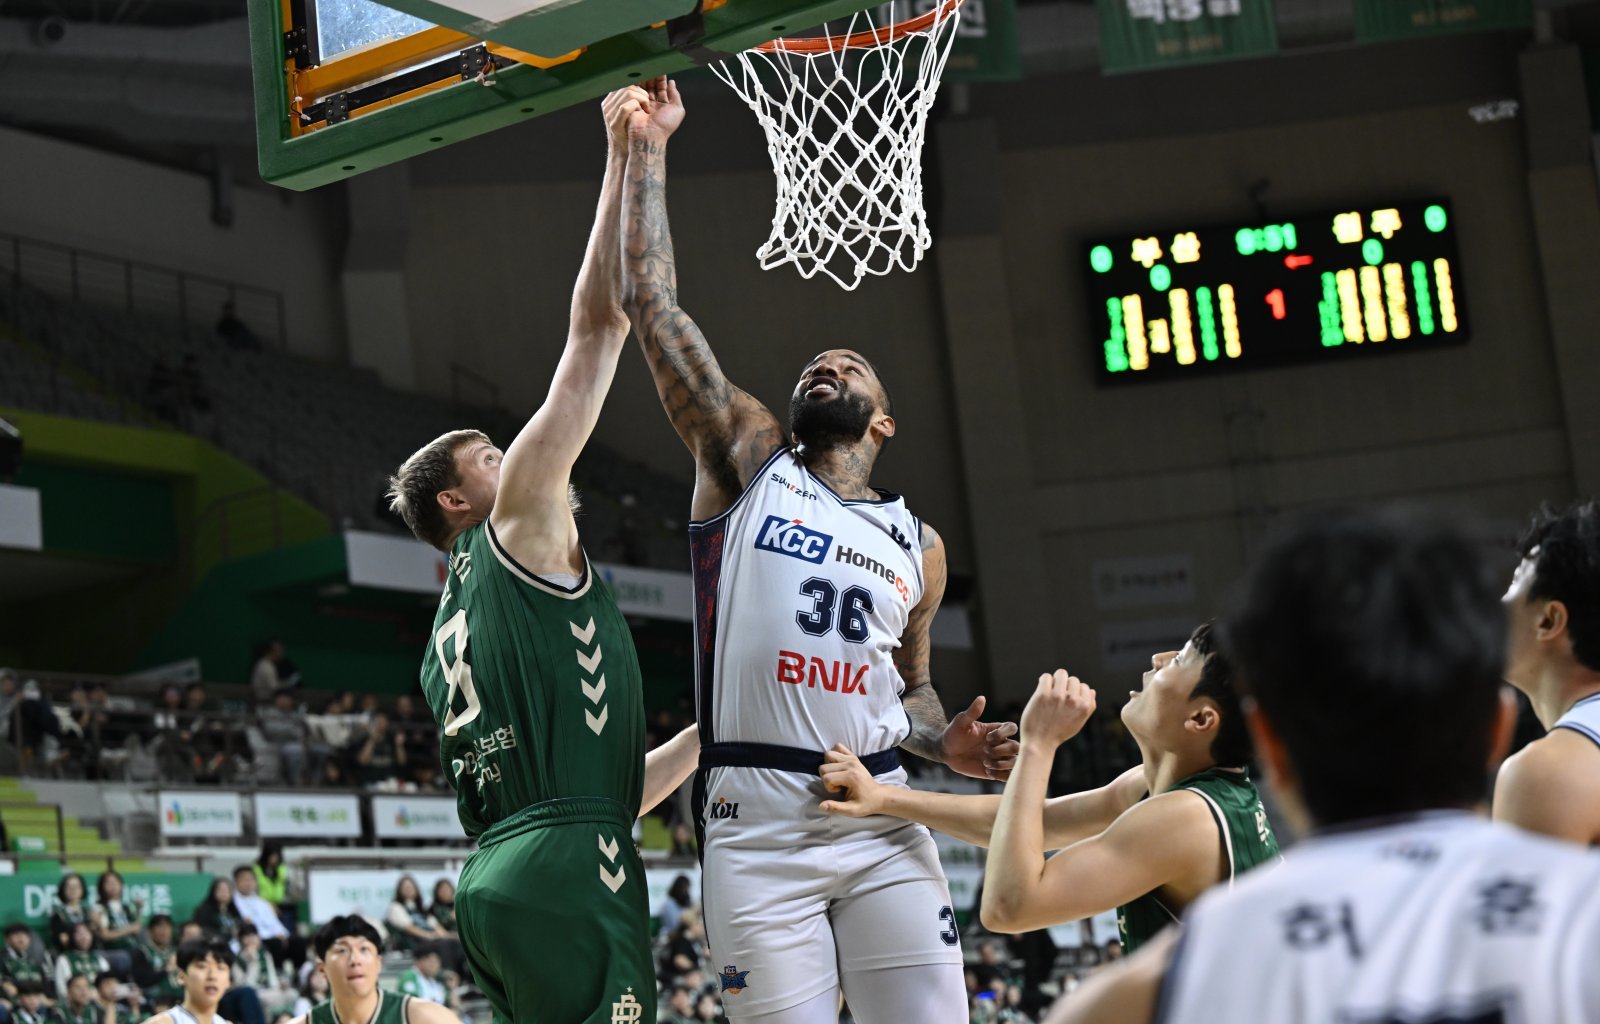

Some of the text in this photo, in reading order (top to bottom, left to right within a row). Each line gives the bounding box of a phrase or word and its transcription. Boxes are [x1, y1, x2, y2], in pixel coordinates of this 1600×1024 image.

[1264, 288, 1286, 320] 1
[761, 520, 825, 560] KCC
[796, 576, 874, 644] 36
[435, 608, 481, 737] 8
[777, 650, 870, 696] BNK
[710, 798, 739, 819] KBL
[938, 905, 959, 947] 3
